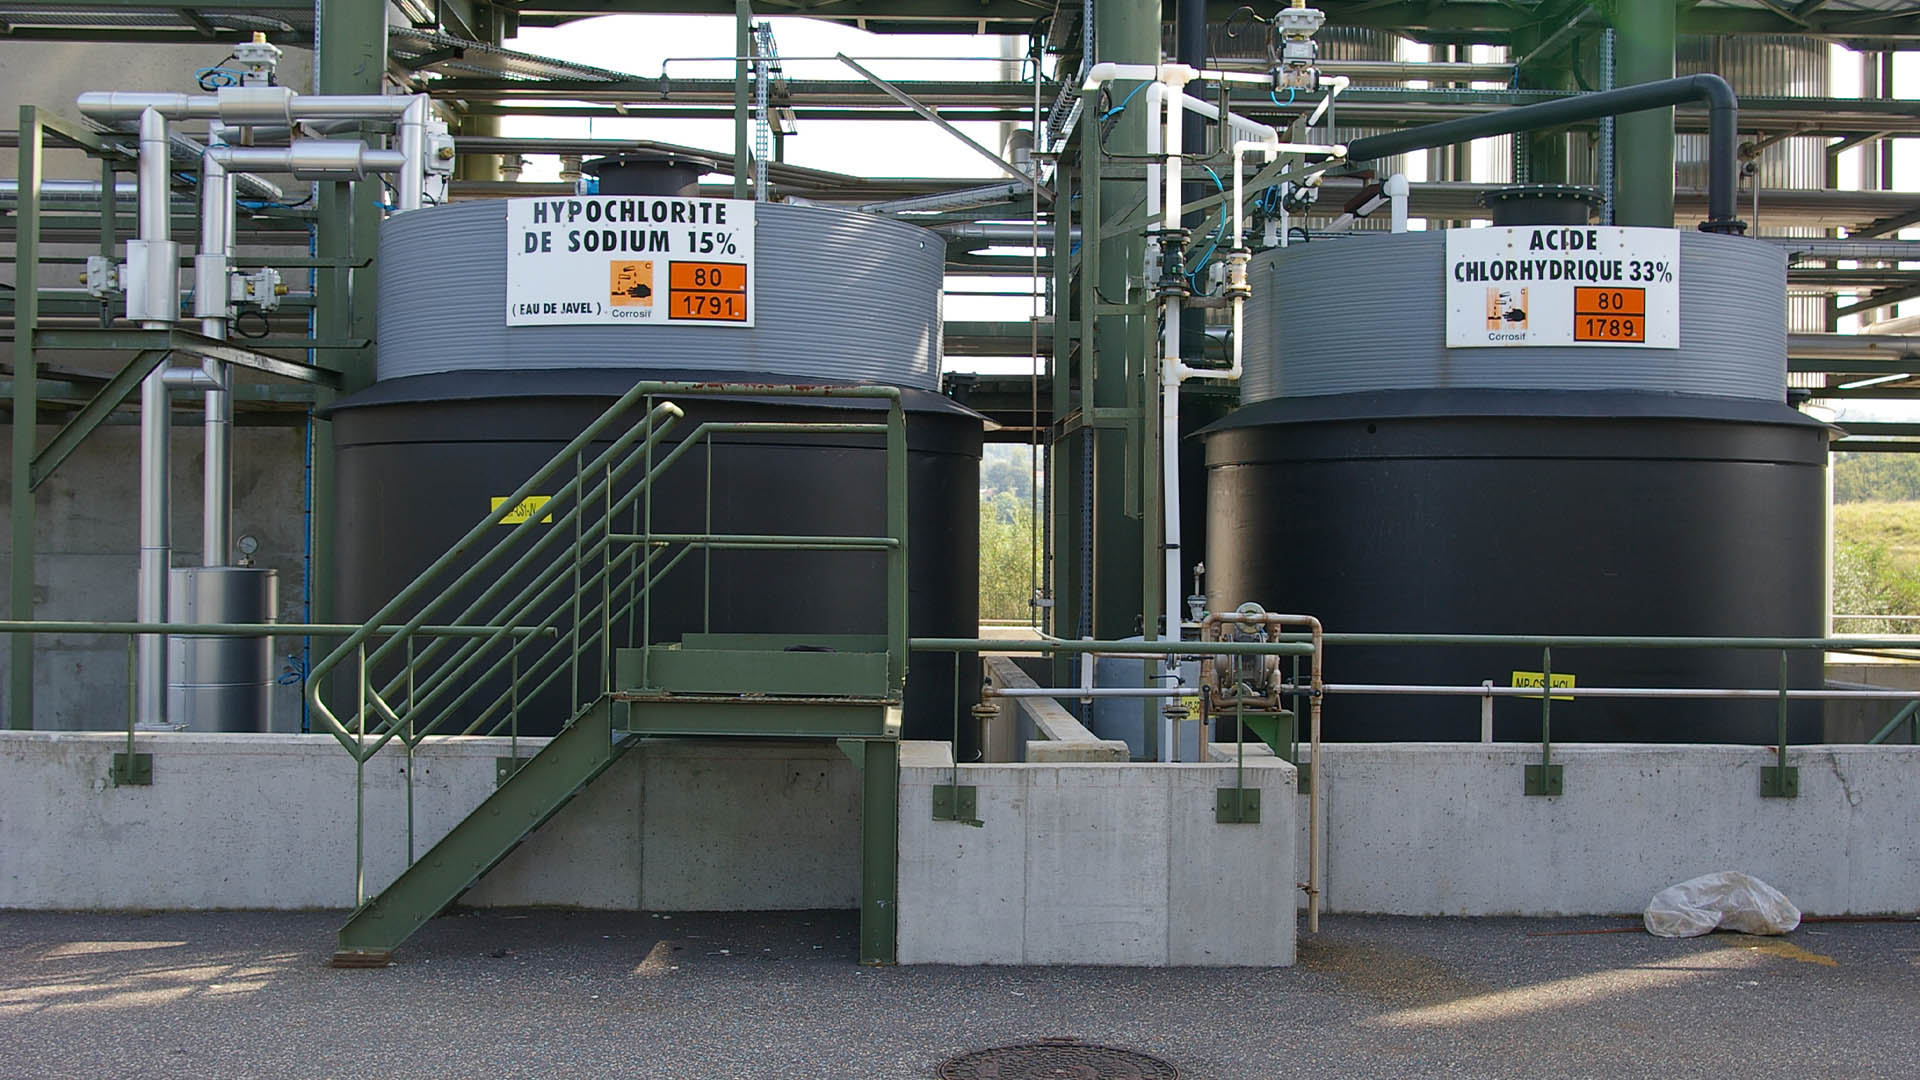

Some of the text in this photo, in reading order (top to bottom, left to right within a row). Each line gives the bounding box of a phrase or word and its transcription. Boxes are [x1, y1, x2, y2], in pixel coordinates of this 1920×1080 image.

[533, 200, 727, 224] HYPOCHLORITE
[525, 230, 737, 255] DE SODIUM 15%
[1529, 230, 1598, 250] ACIDE
[694, 268, 722, 287] 80
[1454, 259, 1673, 283] CHLORHYDRIQUE 33%
[543, 303, 557, 314] DE
[683, 296, 734, 317] 1791
[1598, 292, 1624, 310] 80
[1488, 332, 1526, 341] Corrosif
[1586, 319, 1635, 337] 1789
